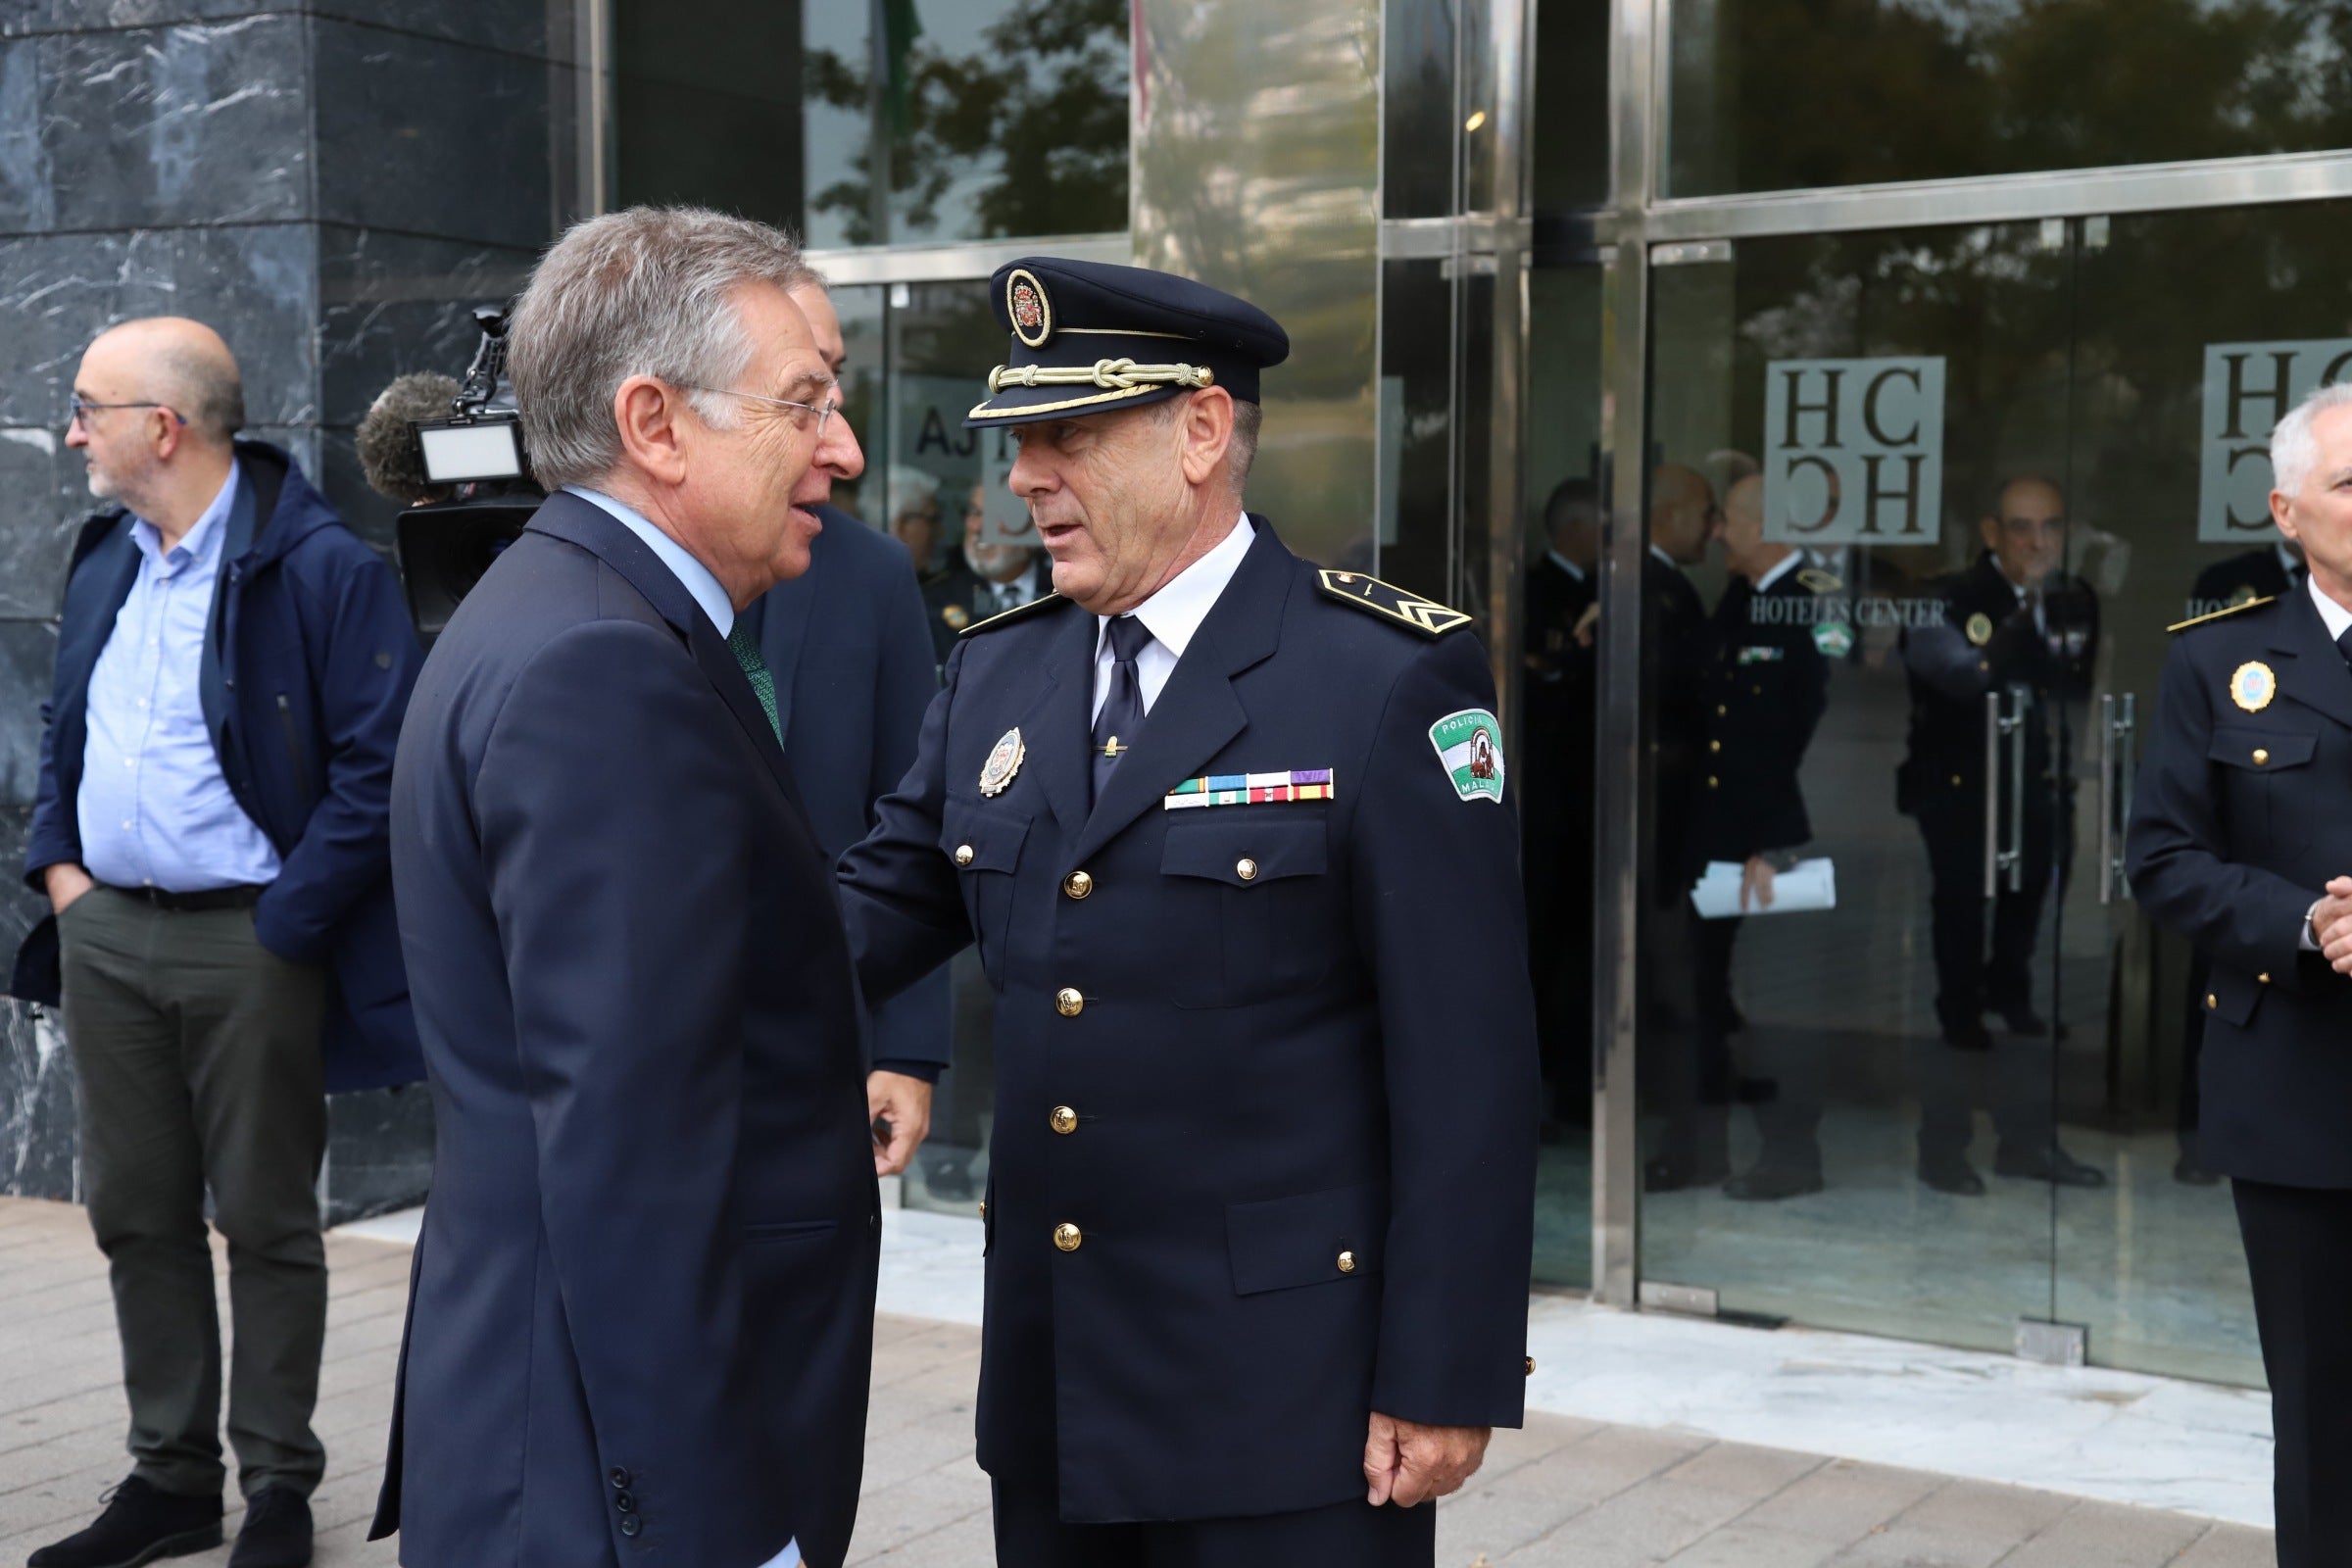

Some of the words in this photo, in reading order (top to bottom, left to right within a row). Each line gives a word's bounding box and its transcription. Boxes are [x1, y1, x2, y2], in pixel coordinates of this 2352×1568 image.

[1779, 367, 1922, 449] HC
[1750, 595, 1851, 625] HOTELES
[1855, 598, 1946, 628] CENTER
